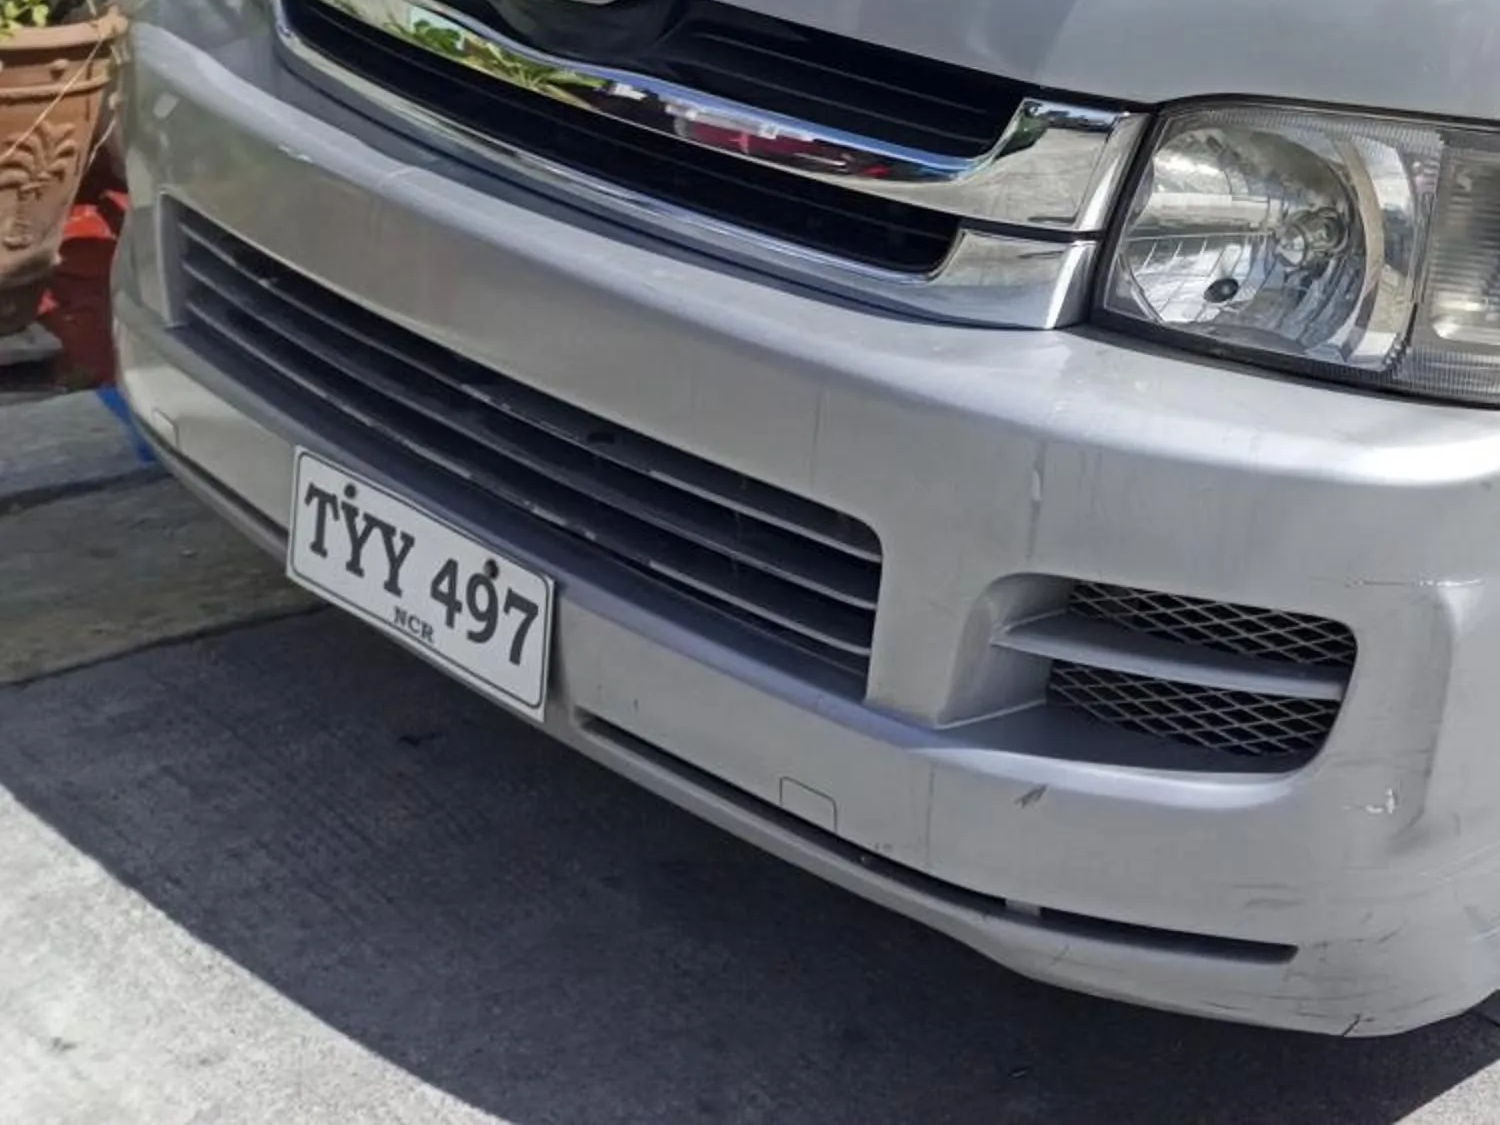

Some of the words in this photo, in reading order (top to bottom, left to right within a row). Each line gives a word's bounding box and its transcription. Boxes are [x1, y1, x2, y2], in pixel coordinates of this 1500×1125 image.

[304, 482, 416, 598] TYY
[430, 558, 540, 667] 497
[392, 605, 436, 645] NCR
